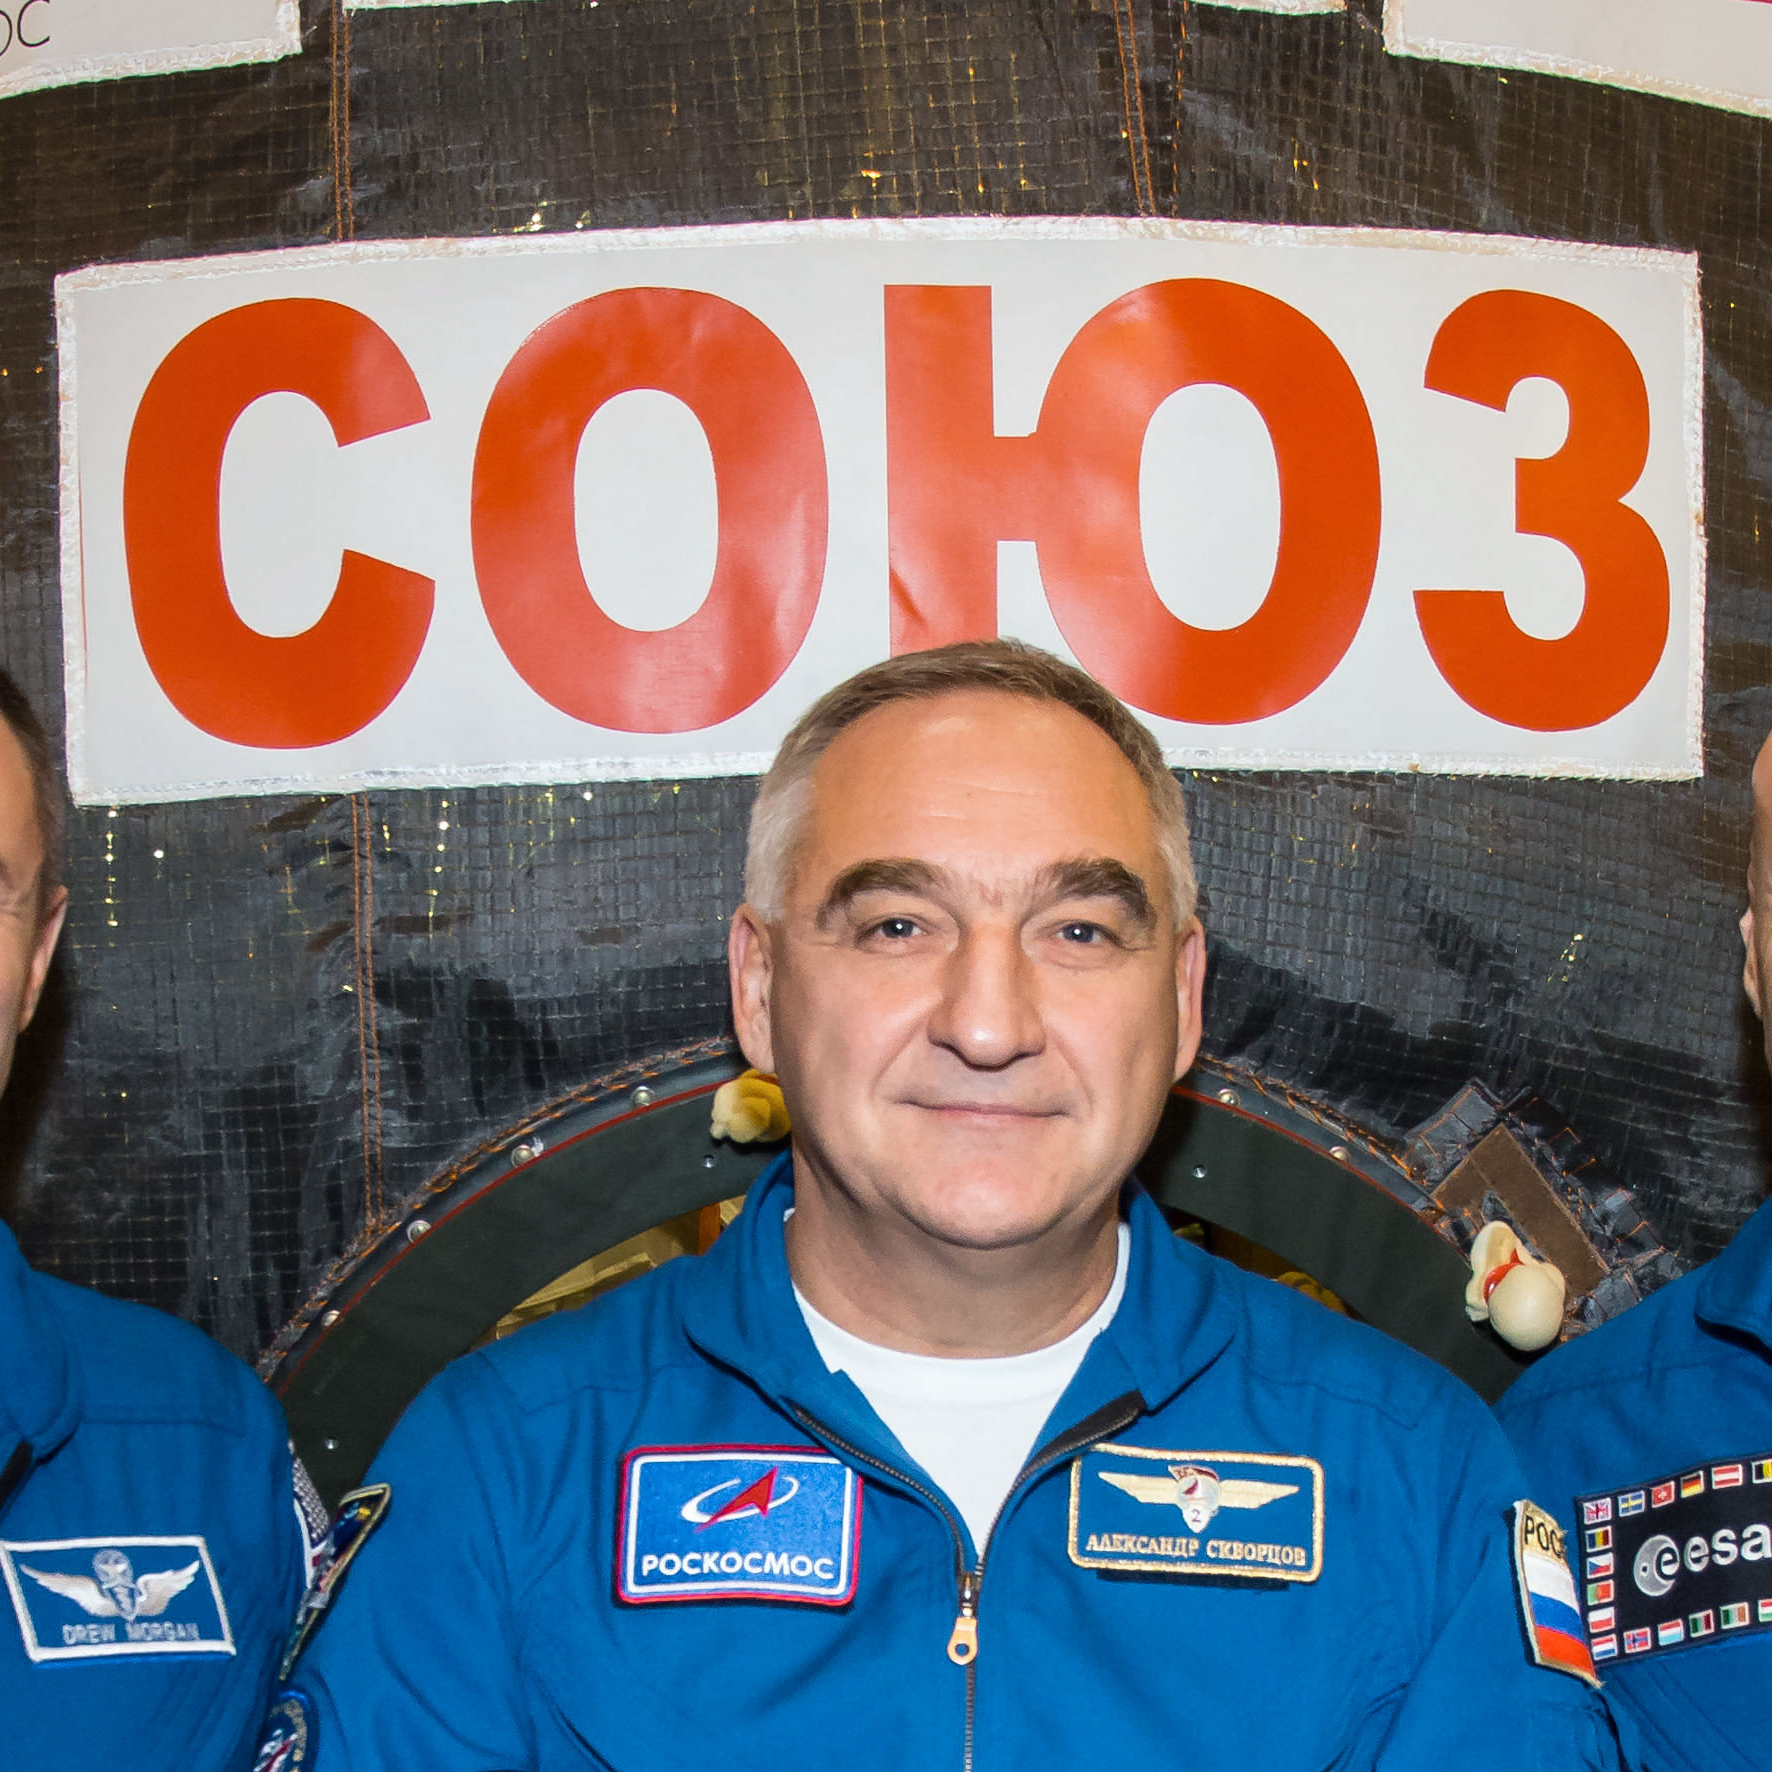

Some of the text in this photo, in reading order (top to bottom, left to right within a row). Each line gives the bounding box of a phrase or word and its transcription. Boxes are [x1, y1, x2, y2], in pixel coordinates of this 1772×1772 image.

[123, 278, 1670, 750] СОЮЗ
[1085, 1533, 1306, 1566] АЛЕКСАНДР СКВОРЦОВ
[1683, 1523, 1772, 1573] esa
[642, 1551, 835, 1580] РОСКОСМОС
[62, 1621, 199, 1645] DREW MORGAN
